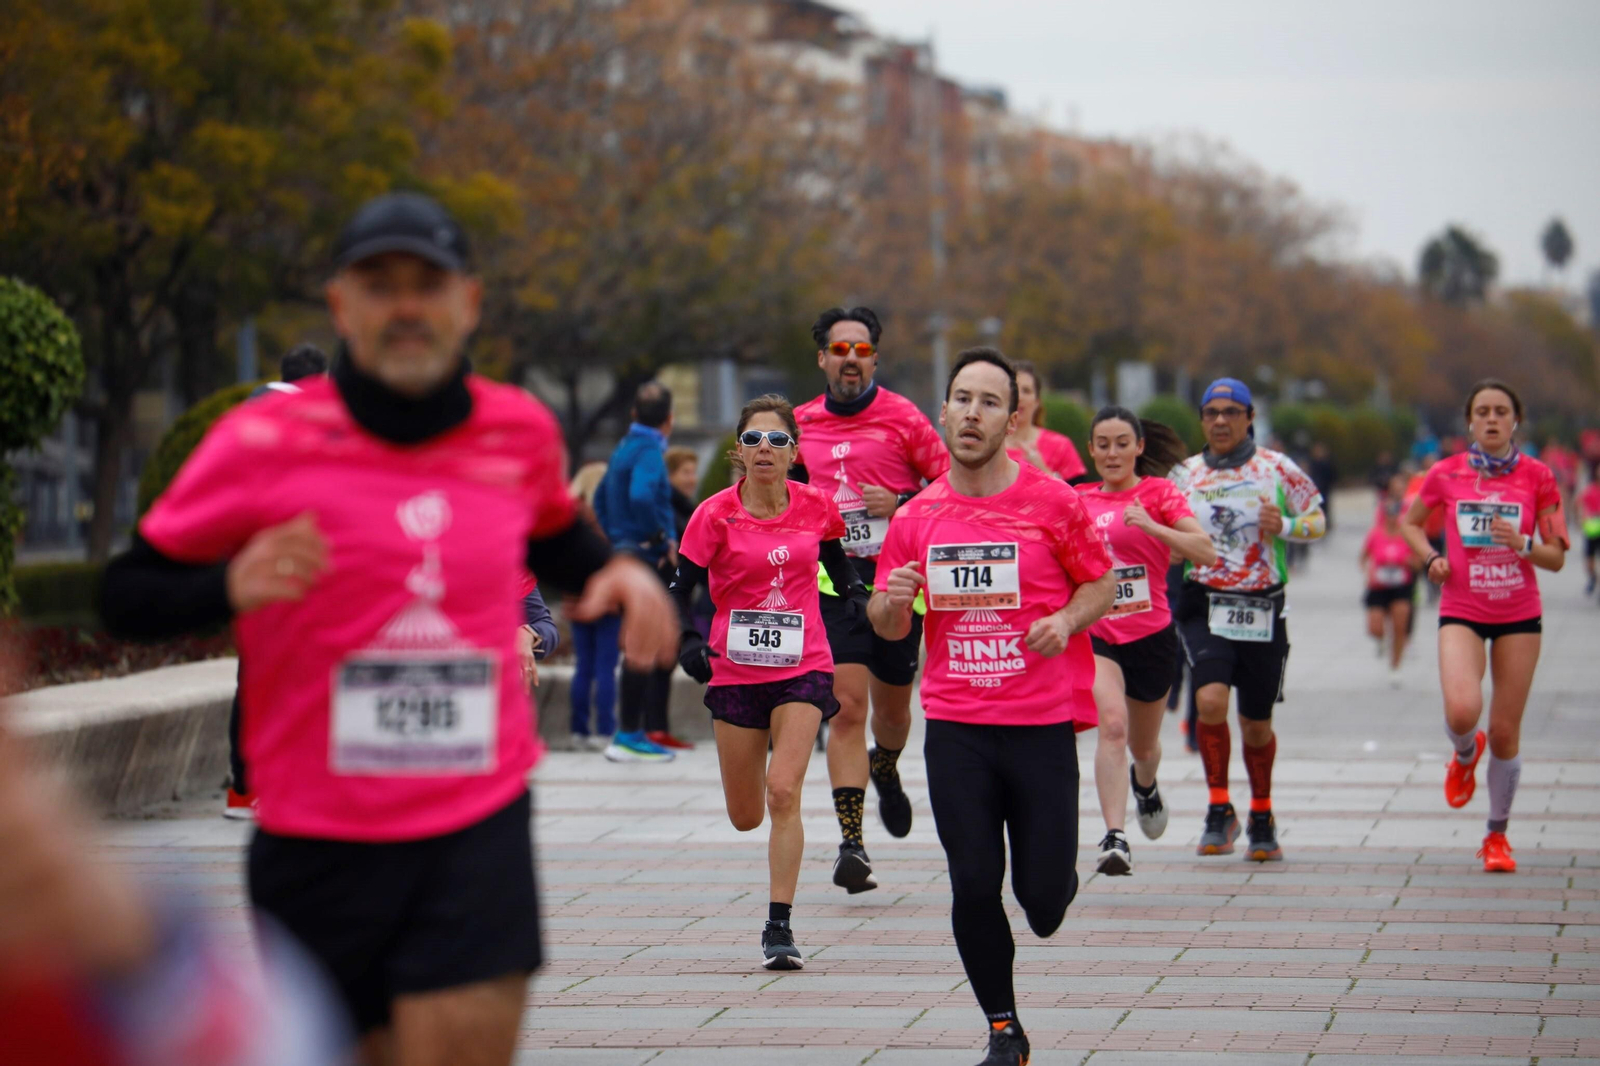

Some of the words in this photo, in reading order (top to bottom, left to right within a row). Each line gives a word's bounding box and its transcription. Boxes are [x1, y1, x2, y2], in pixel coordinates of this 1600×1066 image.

[950, 566, 993, 587] 1714
[1468, 560, 1522, 579] PINK
[1469, 576, 1525, 588] RUNNING
[1227, 609, 1254, 625] 286
[953, 624, 967, 633] VIII
[748, 628, 782, 648] 543
[947, 636, 1023, 660] PINK
[948, 658, 1026, 673] RUNNING
[969, 678, 1002, 687] 2023
